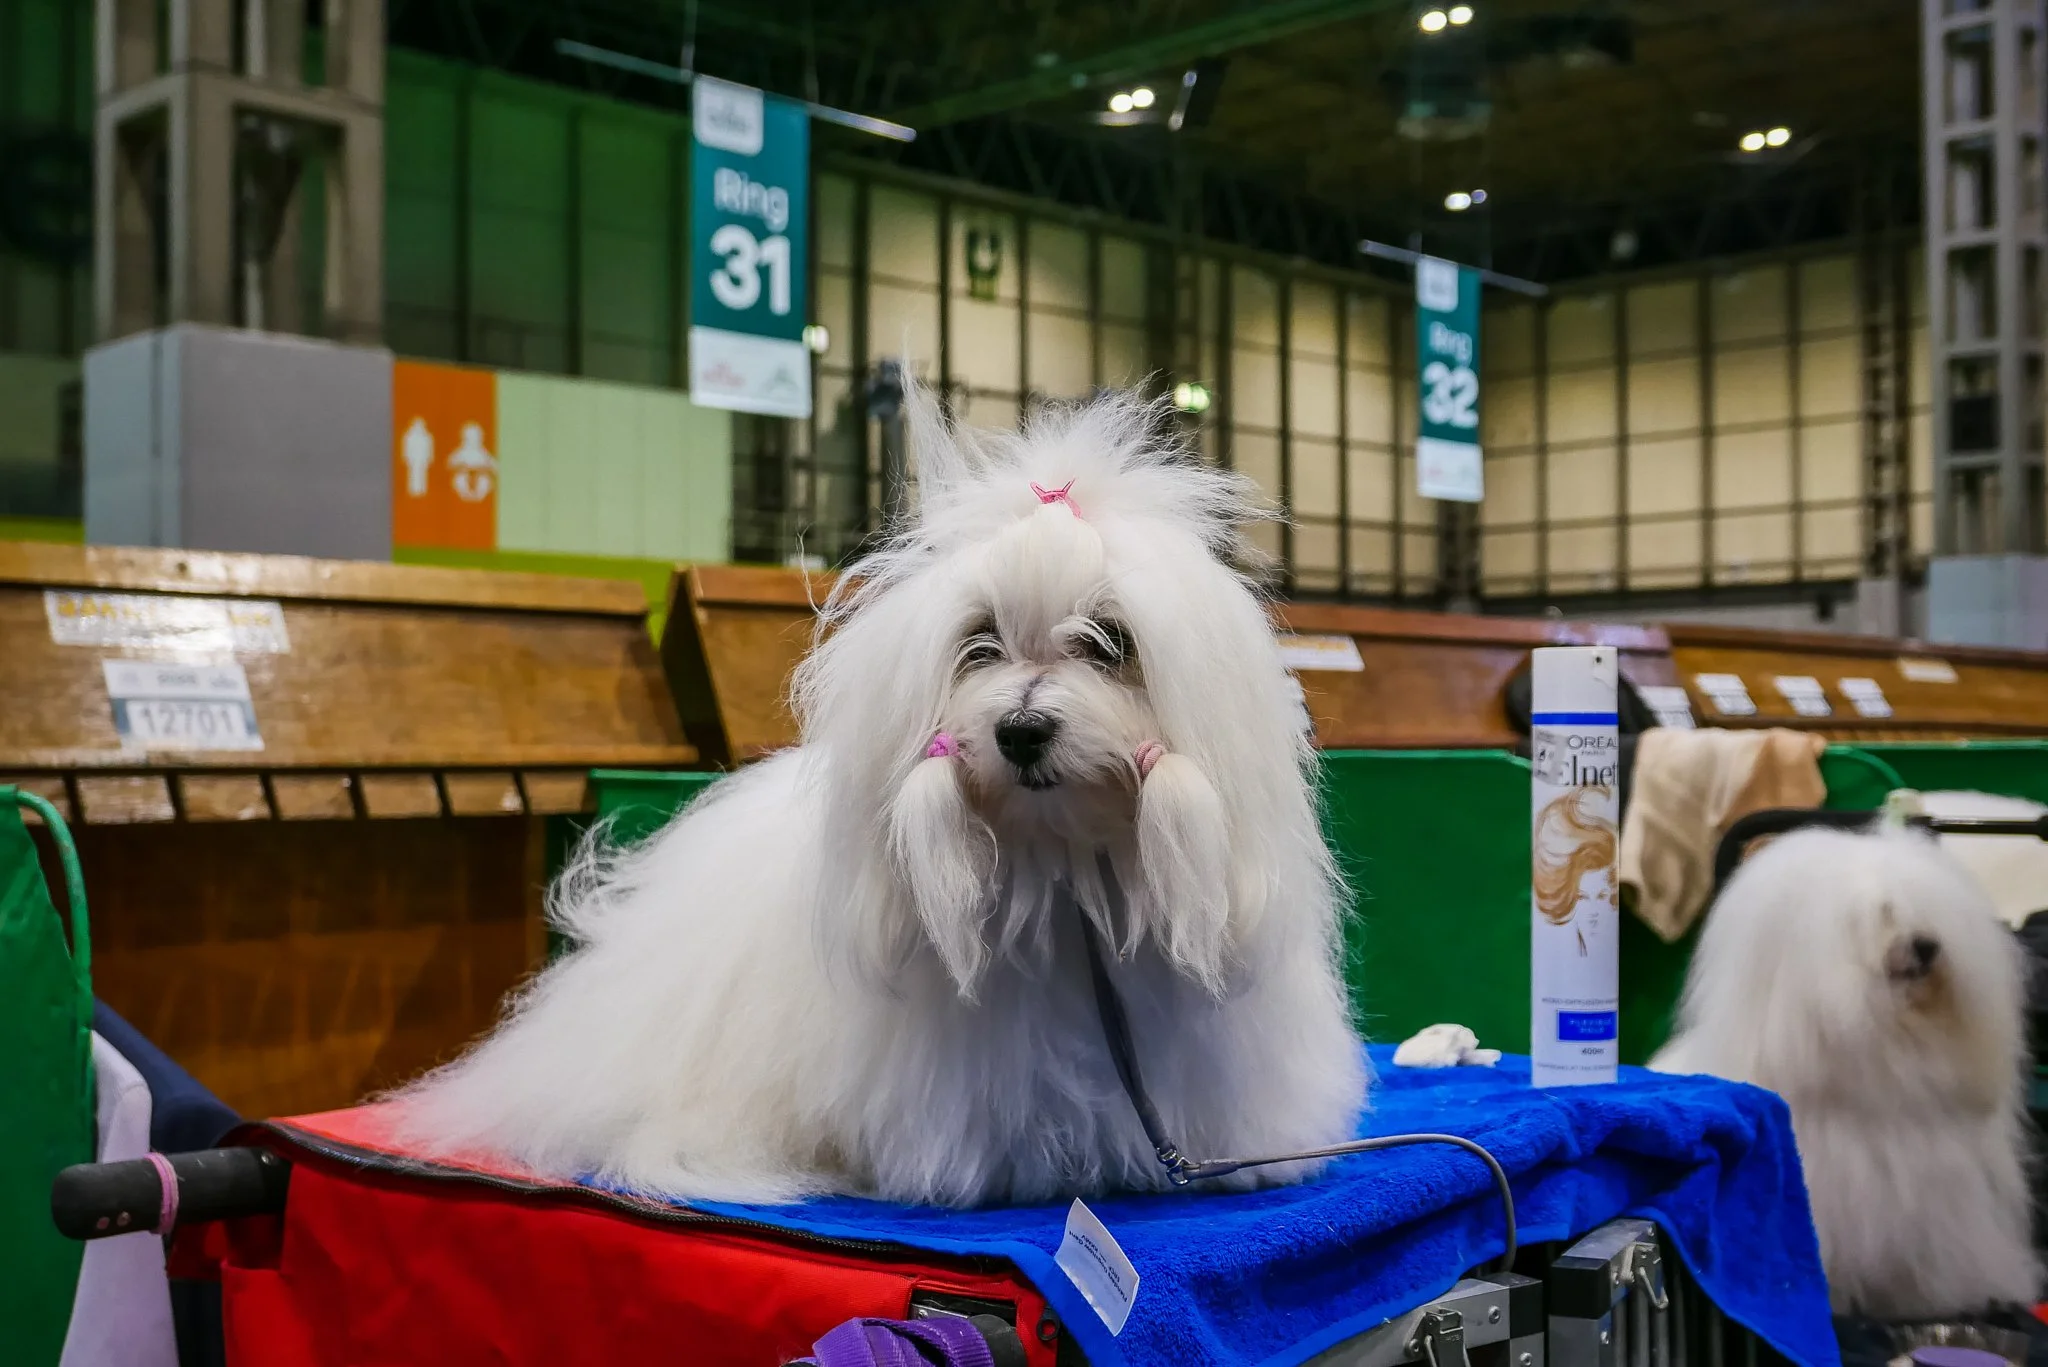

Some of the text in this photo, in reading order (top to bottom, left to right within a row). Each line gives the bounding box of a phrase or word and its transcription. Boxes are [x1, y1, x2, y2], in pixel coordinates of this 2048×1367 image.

[713, 166, 789, 233] Ring
[709, 224, 791, 316] 31
[1429, 320, 1473, 369] Ring
[1422, 361, 1480, 429] 32
[140, 701, 234, 737] 12701
